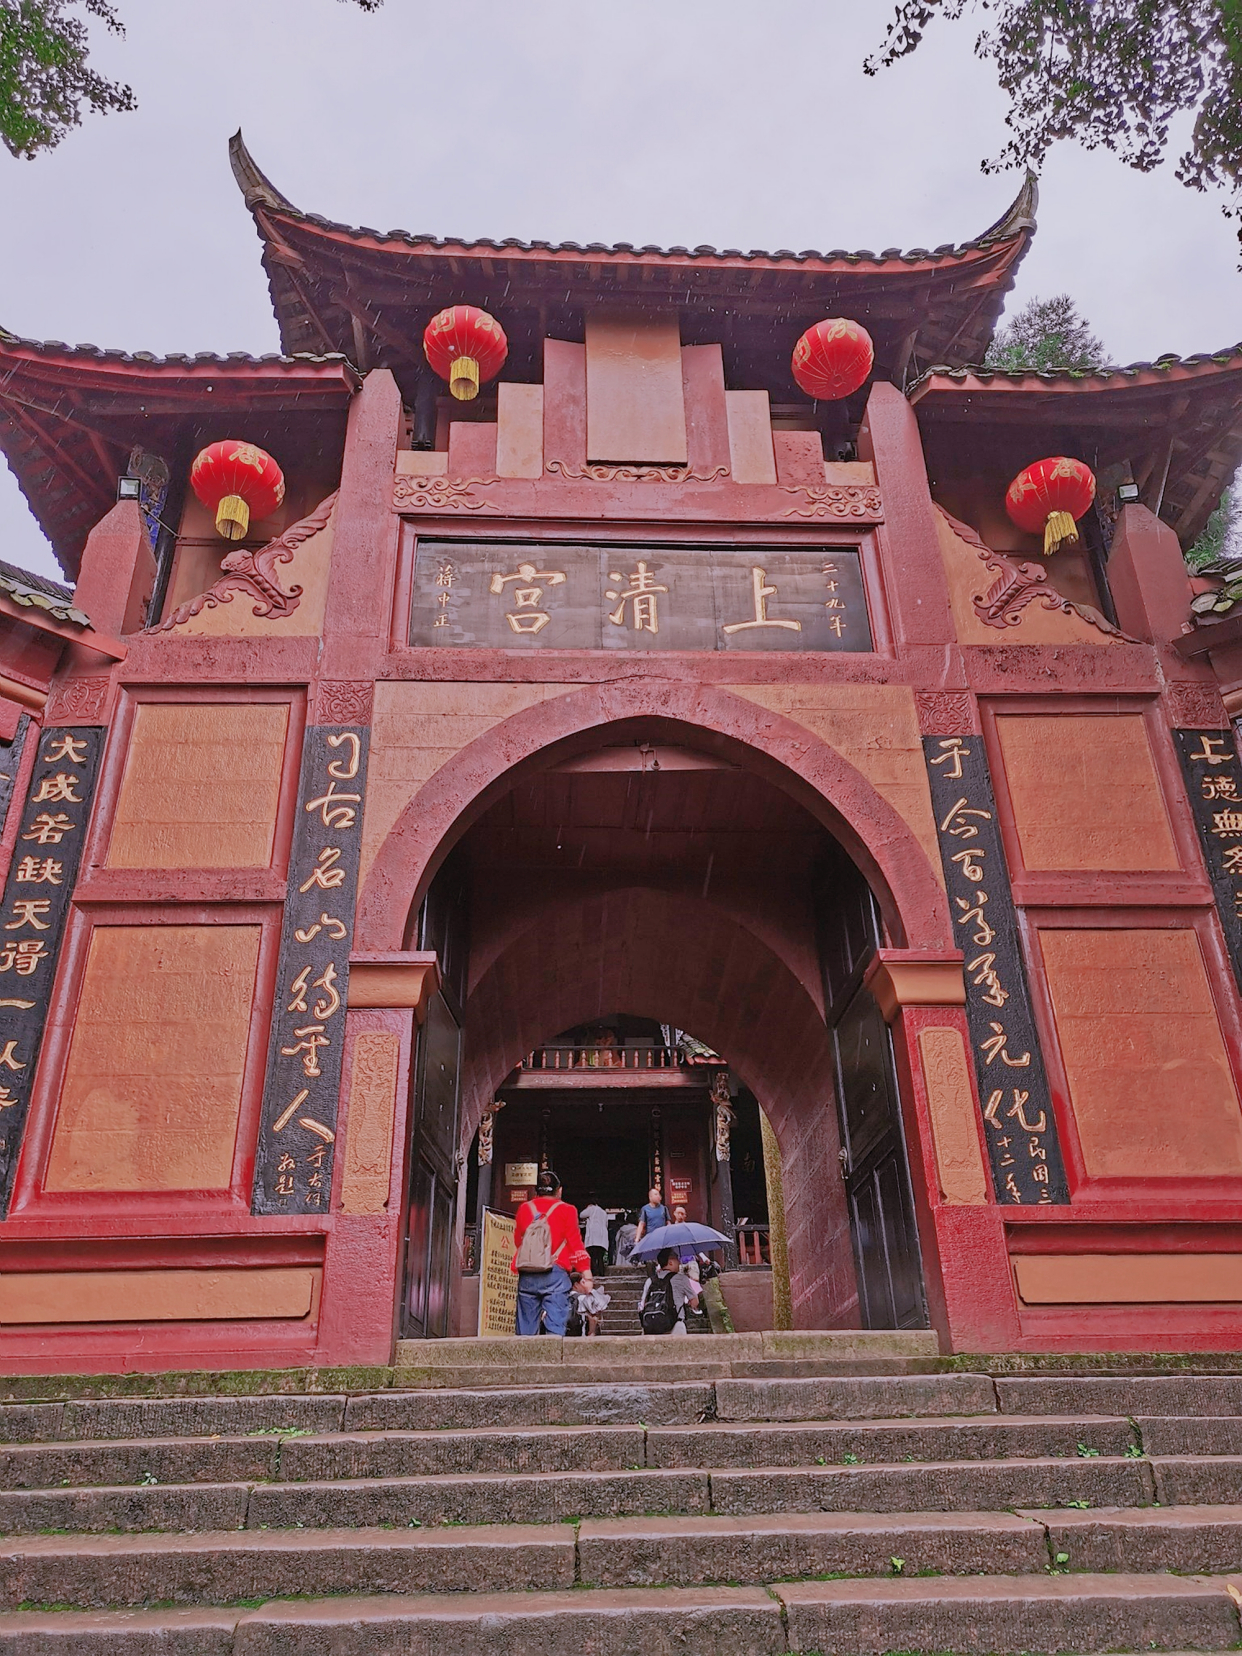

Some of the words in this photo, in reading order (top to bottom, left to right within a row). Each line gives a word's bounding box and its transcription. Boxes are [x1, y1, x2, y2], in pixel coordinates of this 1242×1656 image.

[822, 563, 847, 638] 二十九年
[1189, 735, 1242, 918] 上德無
[0, 734, 87, 1111] 大成若缺天得一
